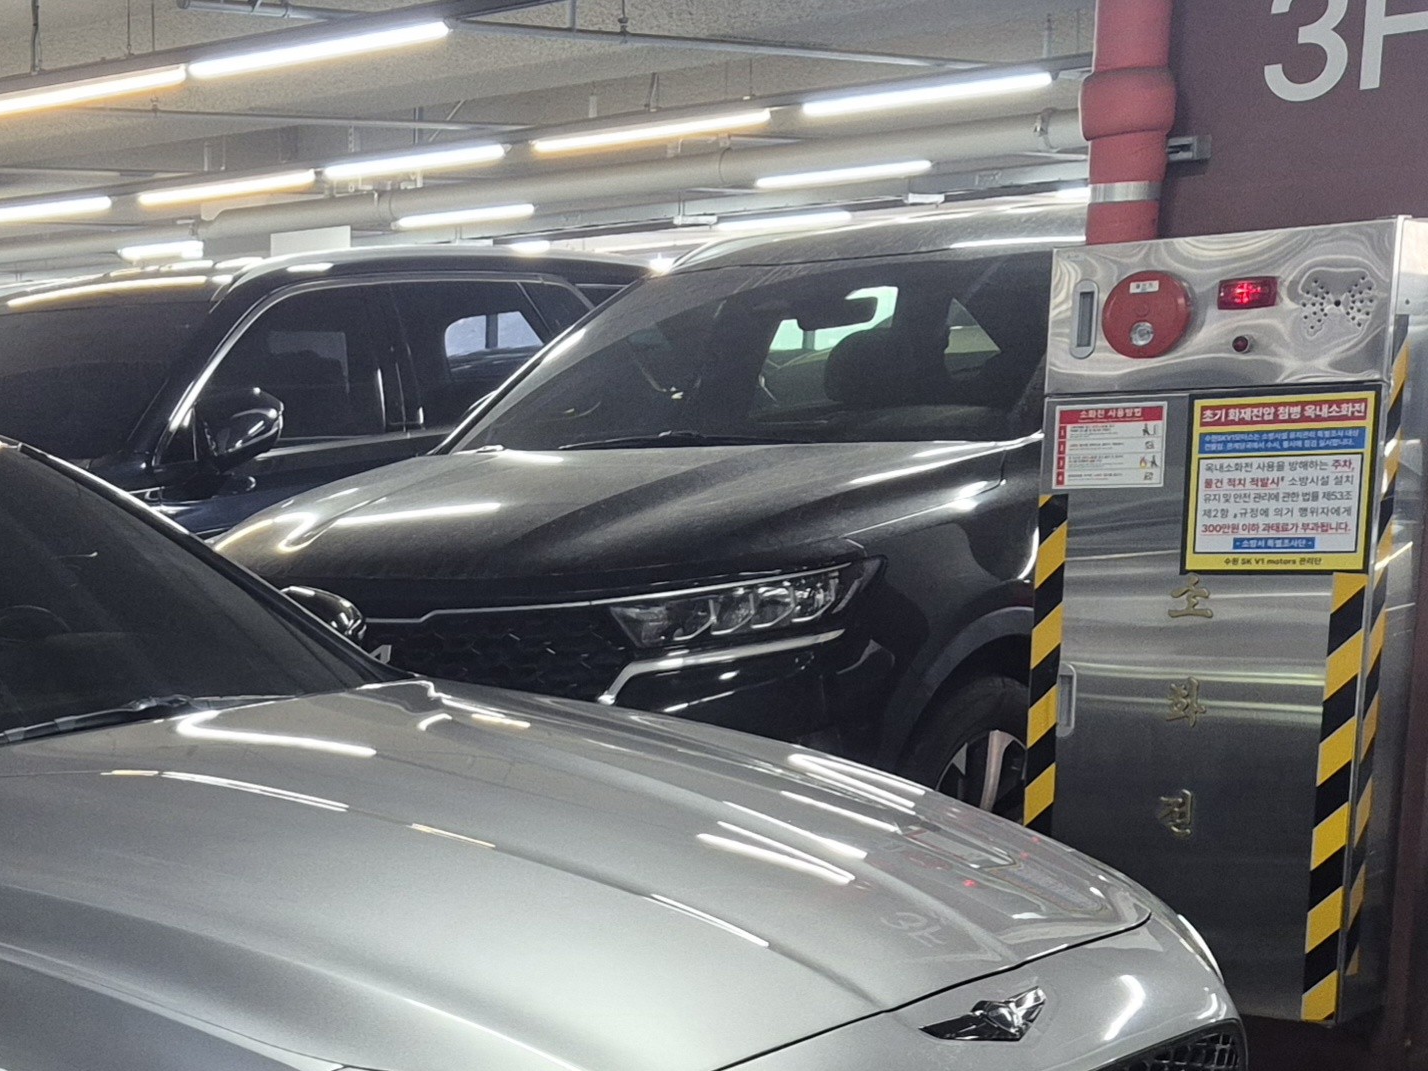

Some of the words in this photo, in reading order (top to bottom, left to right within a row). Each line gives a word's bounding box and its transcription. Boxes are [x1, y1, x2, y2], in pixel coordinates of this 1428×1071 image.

[1264, 0, 1428, 101] 3F
[1202, 409, 1225, 422] 초기
[1227, 406, 1274, 421] 화재진압
[1304, 402, 1365, 418] 옥내소화전
[1205, 462, 1253, 473] 옥내소화전
[1256, 461, 1285, 472] 사용을
[1288, 460, 1328, 471] 방해하는
[1288, 475, 1330, 487] 소방시설
[1333, 474, 1354, 486] 설치
[1201, 523, 1240, 534] 300만원
[1242, 522, 1259, 533] 이하
[1262, 522, 1299, 533] 과태료가
